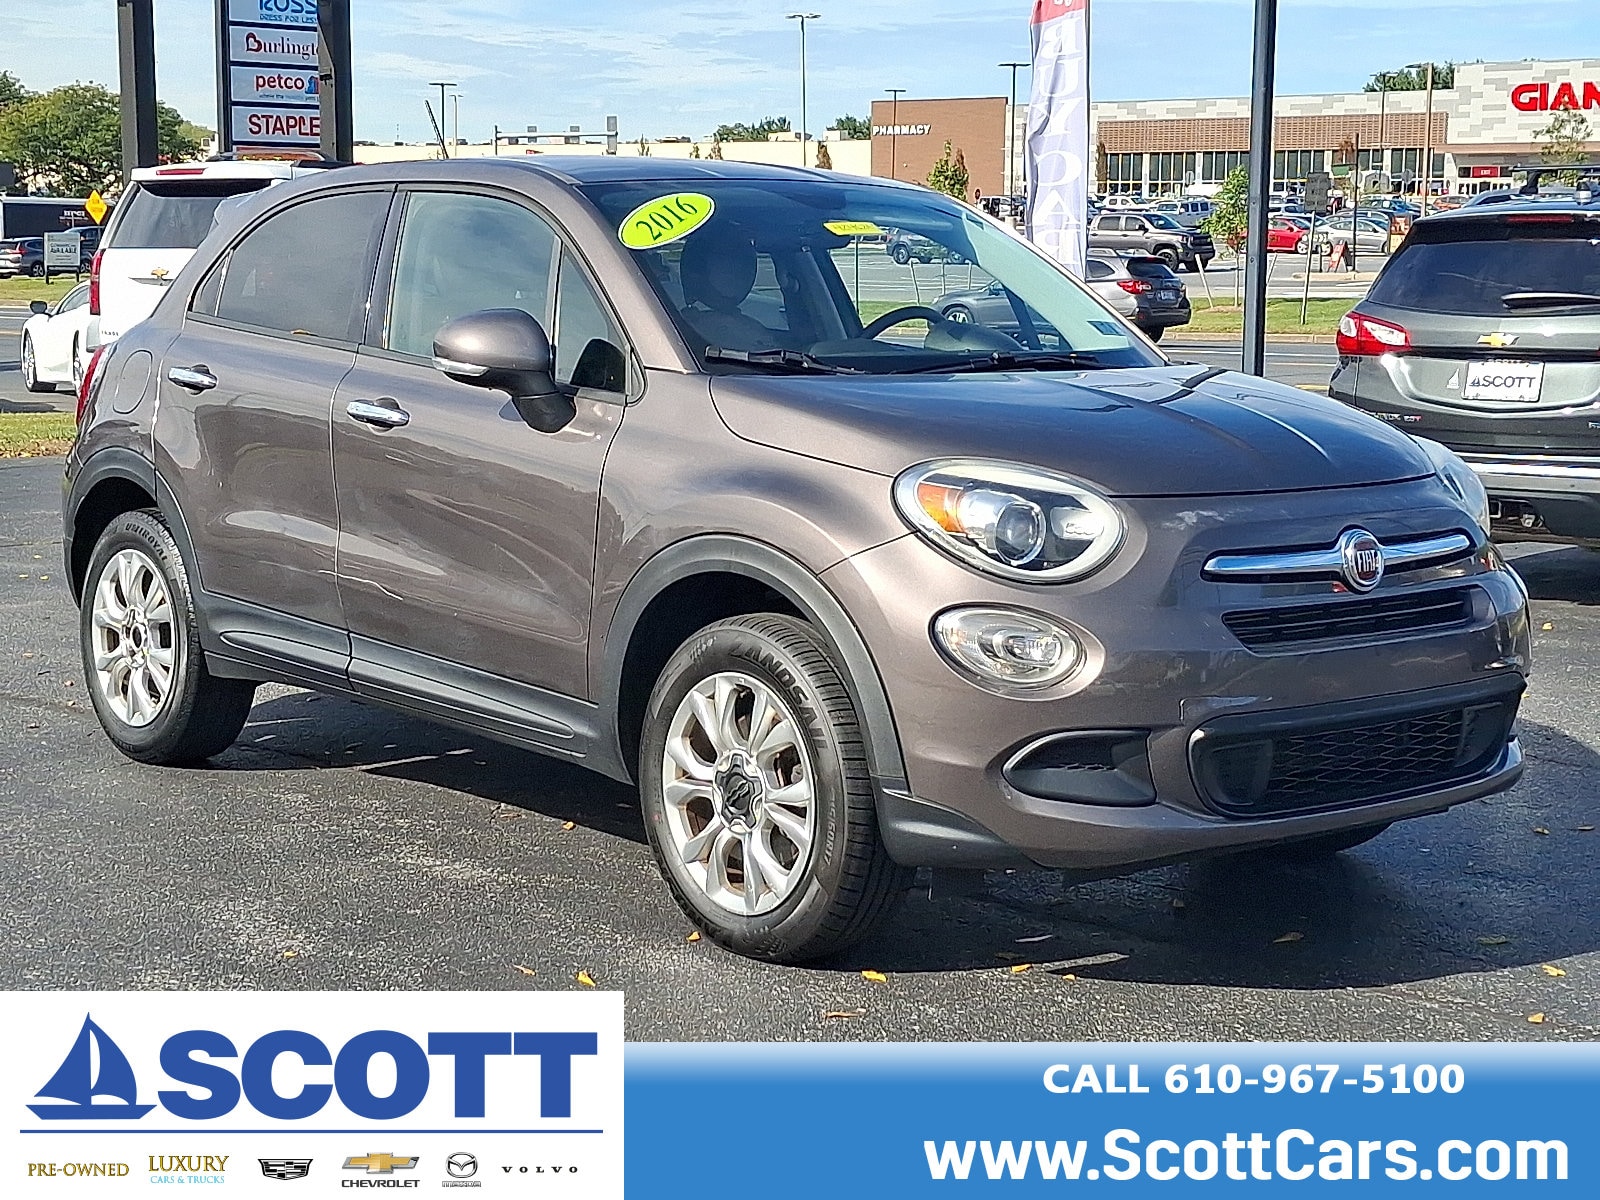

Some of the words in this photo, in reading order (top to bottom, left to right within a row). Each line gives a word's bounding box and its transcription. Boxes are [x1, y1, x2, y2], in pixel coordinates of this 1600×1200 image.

[260, 13, 282, 21] DRESS
[245, 32, 318, 60] Burlingt
[255, 74, 305, 91] petco
[248, 114, 320, 137] STAPLE
[872, 124, 932, 136] PHARMACY
[636, 196, 698, 241] 2016
[1482, 375, 1536, 388] SCOTT
[1356, 550, 1376, 572] FIAT
